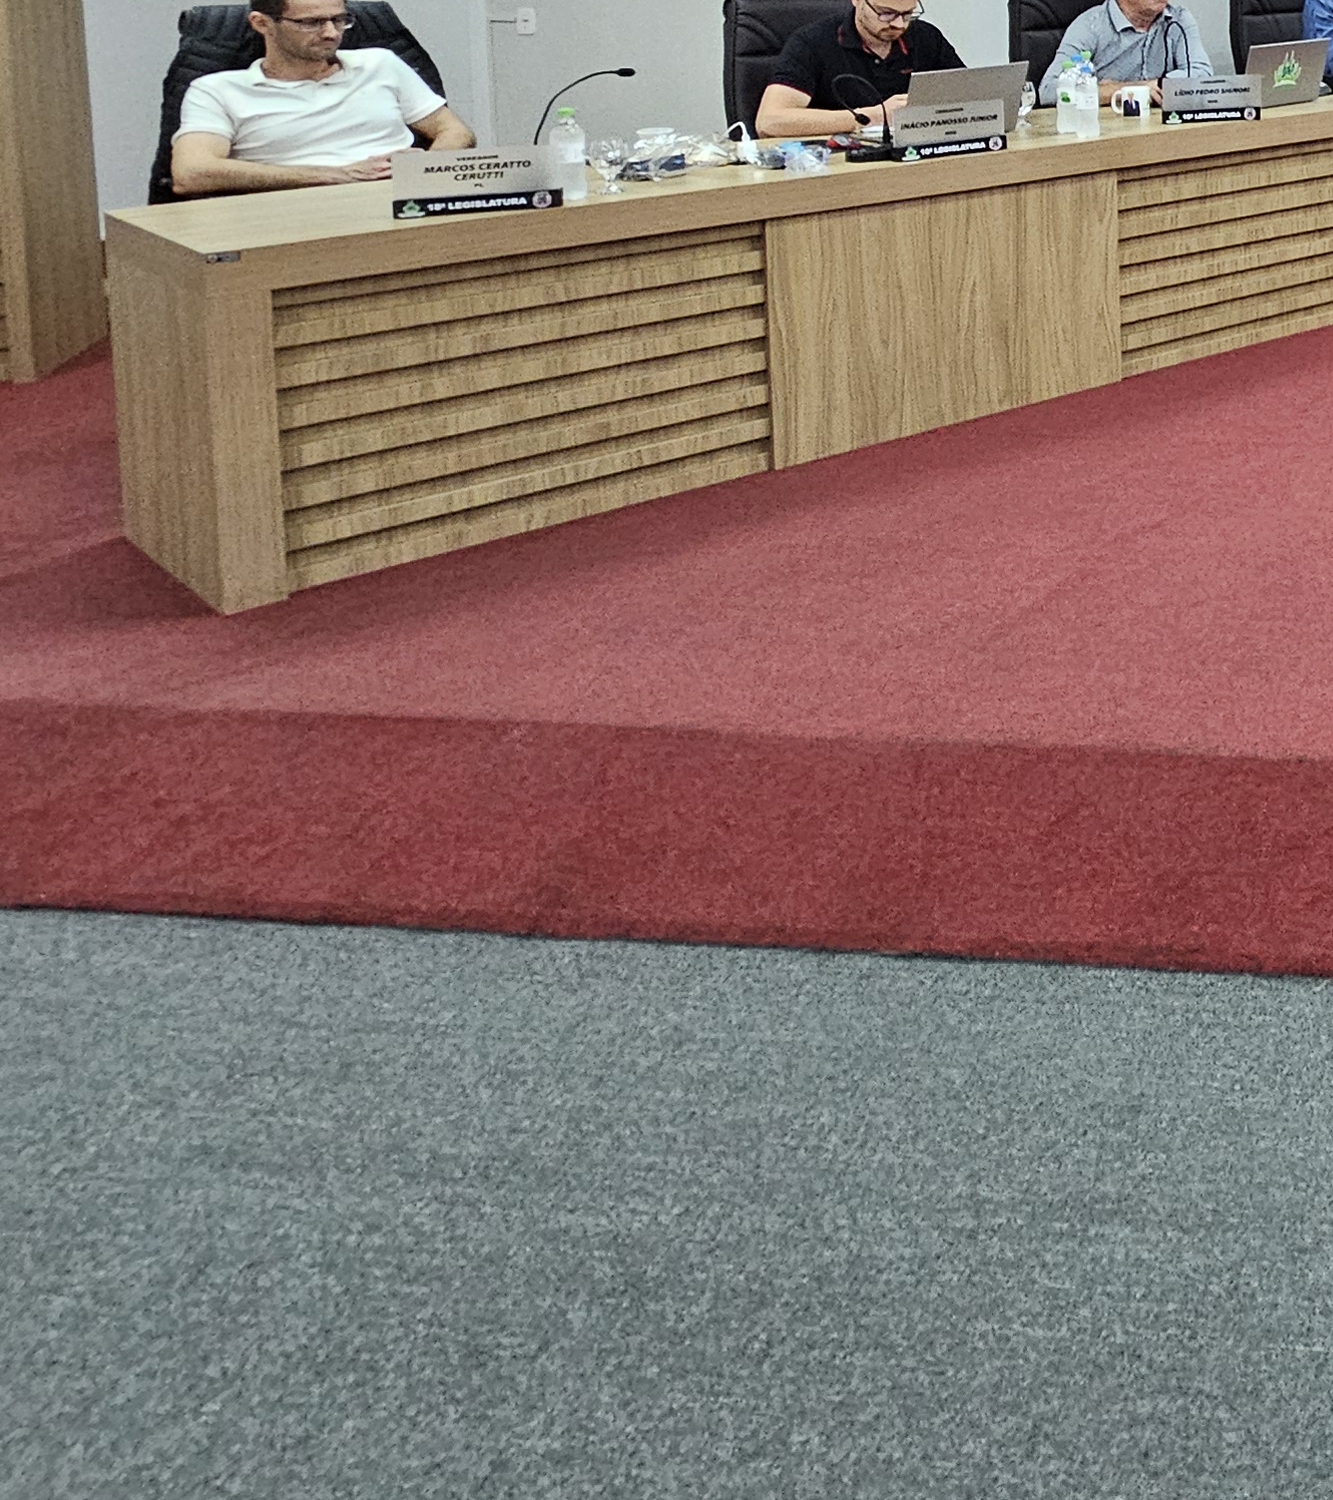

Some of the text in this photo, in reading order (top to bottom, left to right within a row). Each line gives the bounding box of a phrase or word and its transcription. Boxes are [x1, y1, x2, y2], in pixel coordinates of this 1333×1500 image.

[930, 117, 968, 127] PANOSSO
[933, 141, 986, 154] LEGISLATURA
[423, 160, 532, 174] MARCOS CERATTO
[453, 171, 505, 182] CERUTTI
[448, 197, 527, 210] LEGISLATURA
